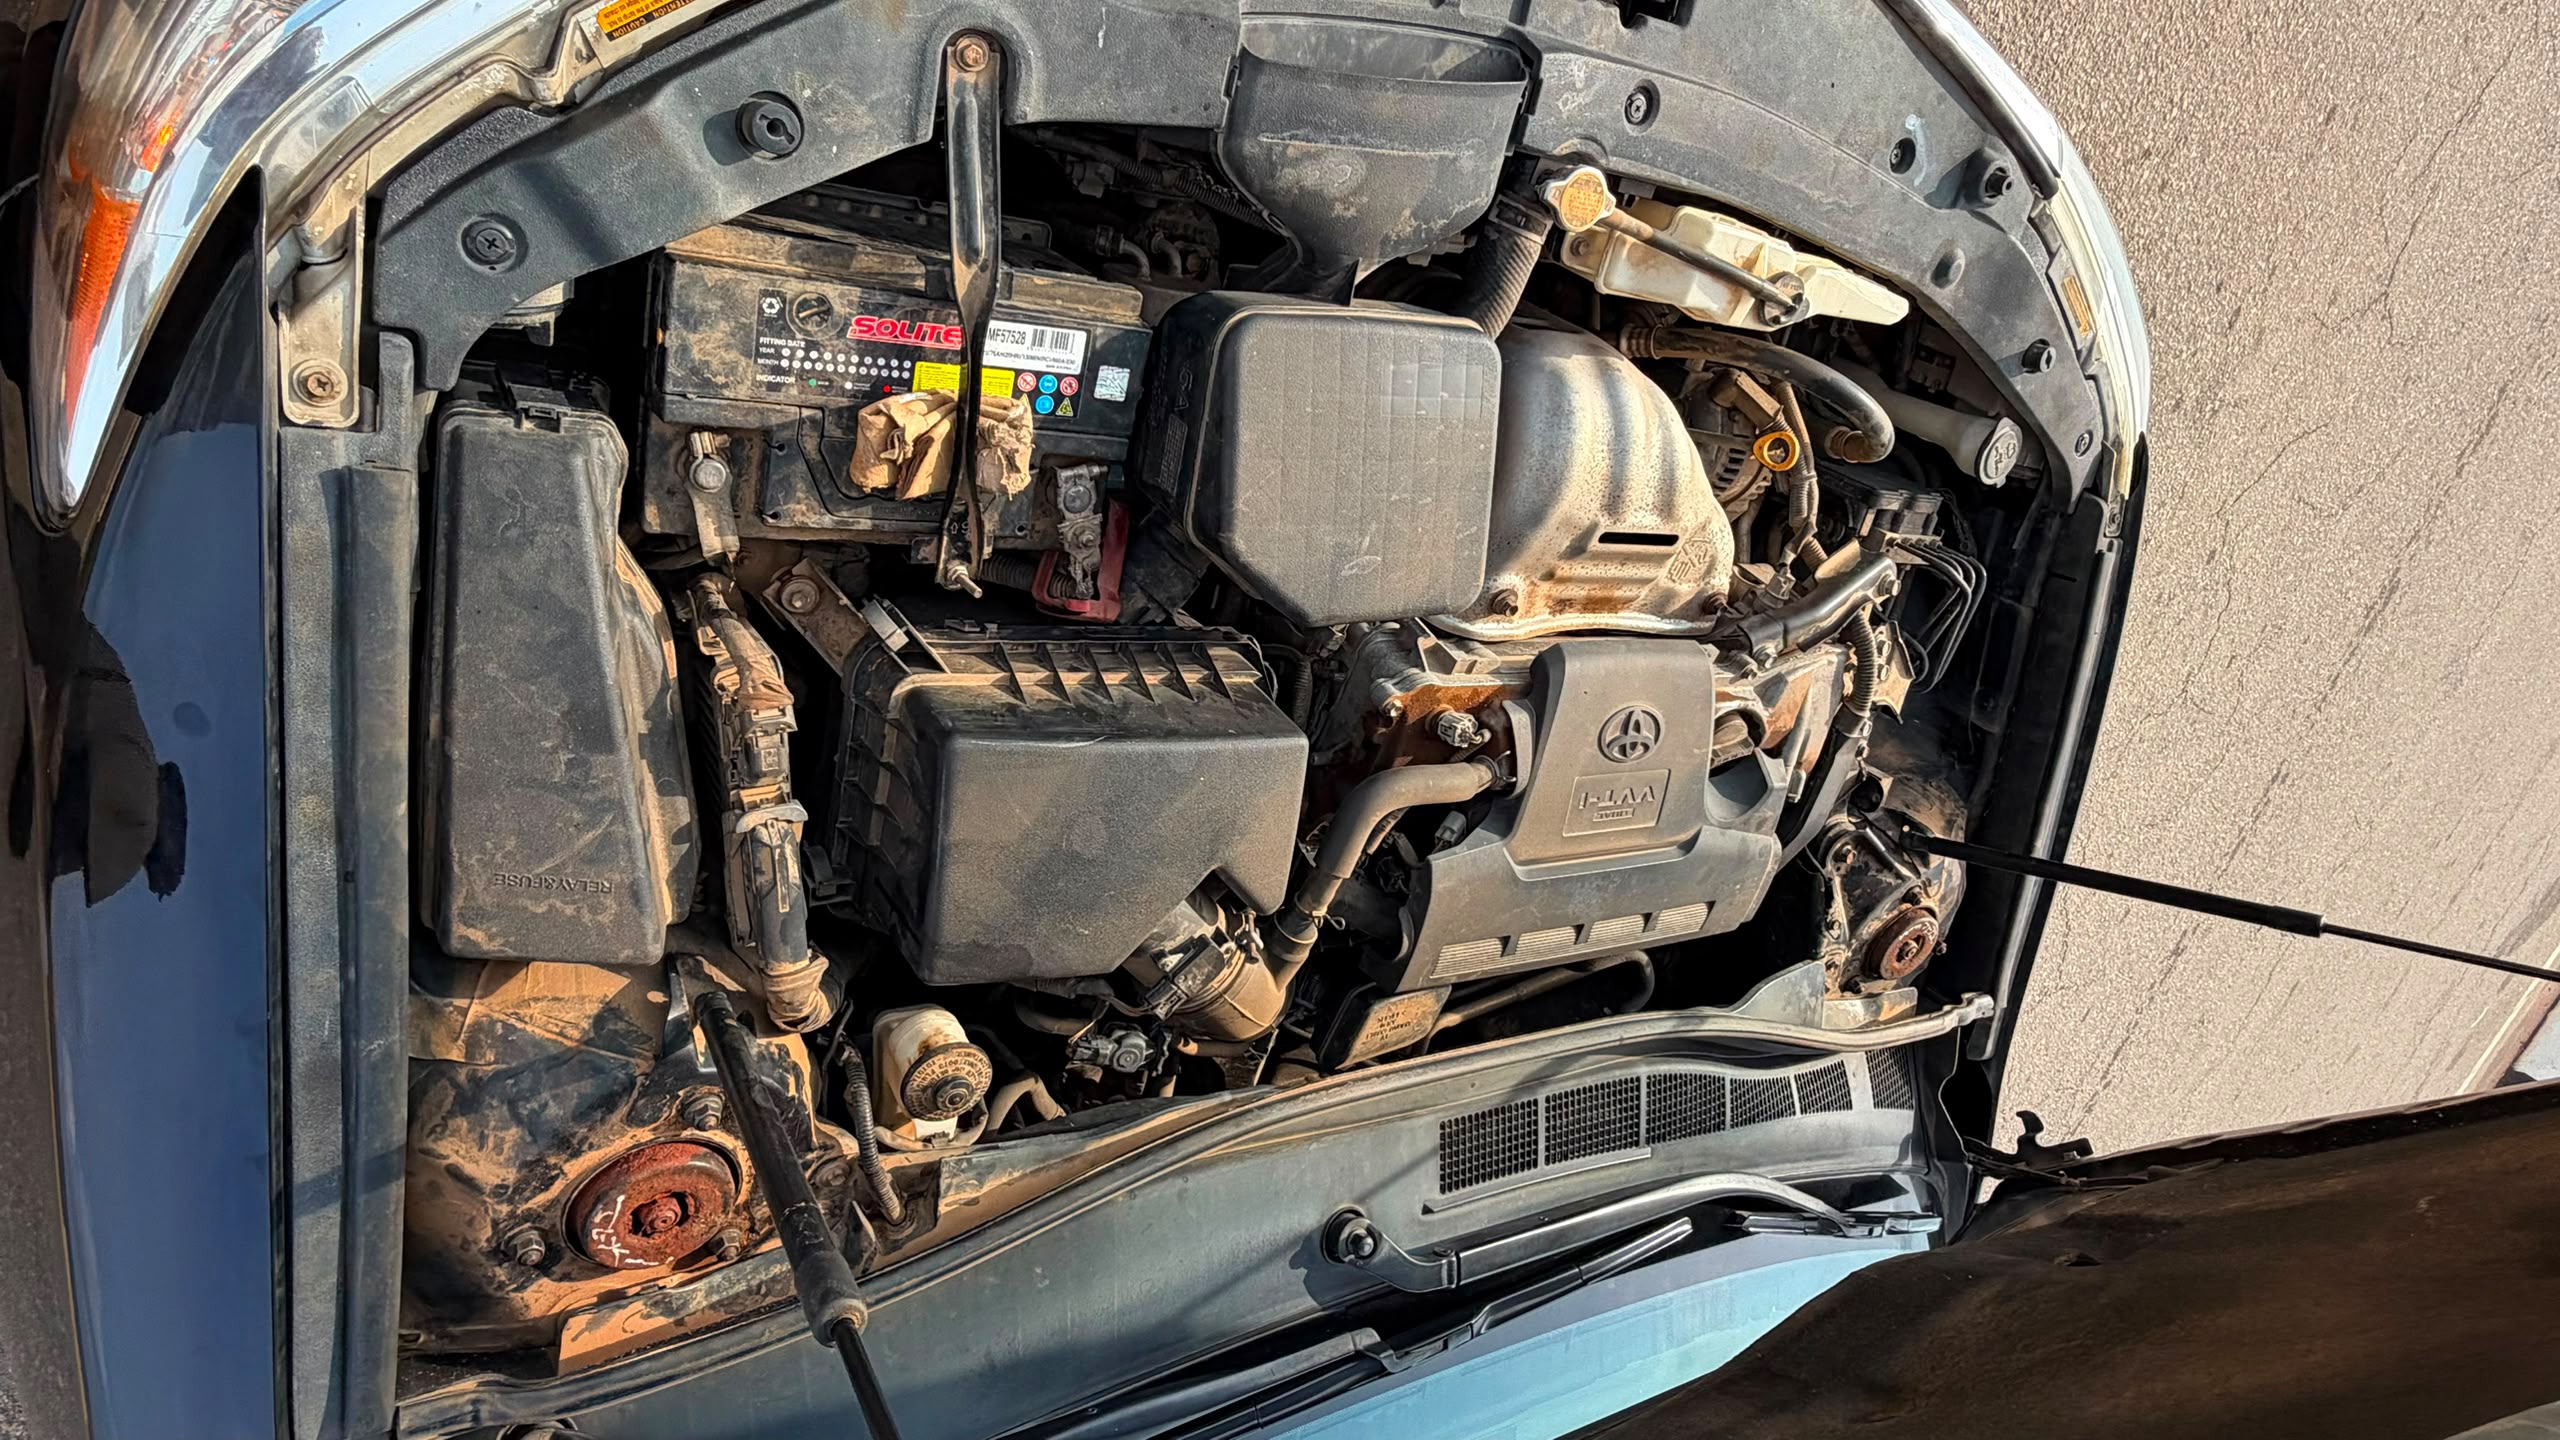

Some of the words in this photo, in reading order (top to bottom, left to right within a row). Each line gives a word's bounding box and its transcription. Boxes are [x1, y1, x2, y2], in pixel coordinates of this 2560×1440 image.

[612, 17, 647, 38] CAUTION
[852, 315, 963, 345] SOLITE
[988, 328, 1026, 345] MF57528
[760, 337, 786, 346] FITTING
[757, 358, 779, 366] MONTH
[756, 374, 796, 384] INDICATOR
[493, 872, 614, 894] RELAY&FUSE
